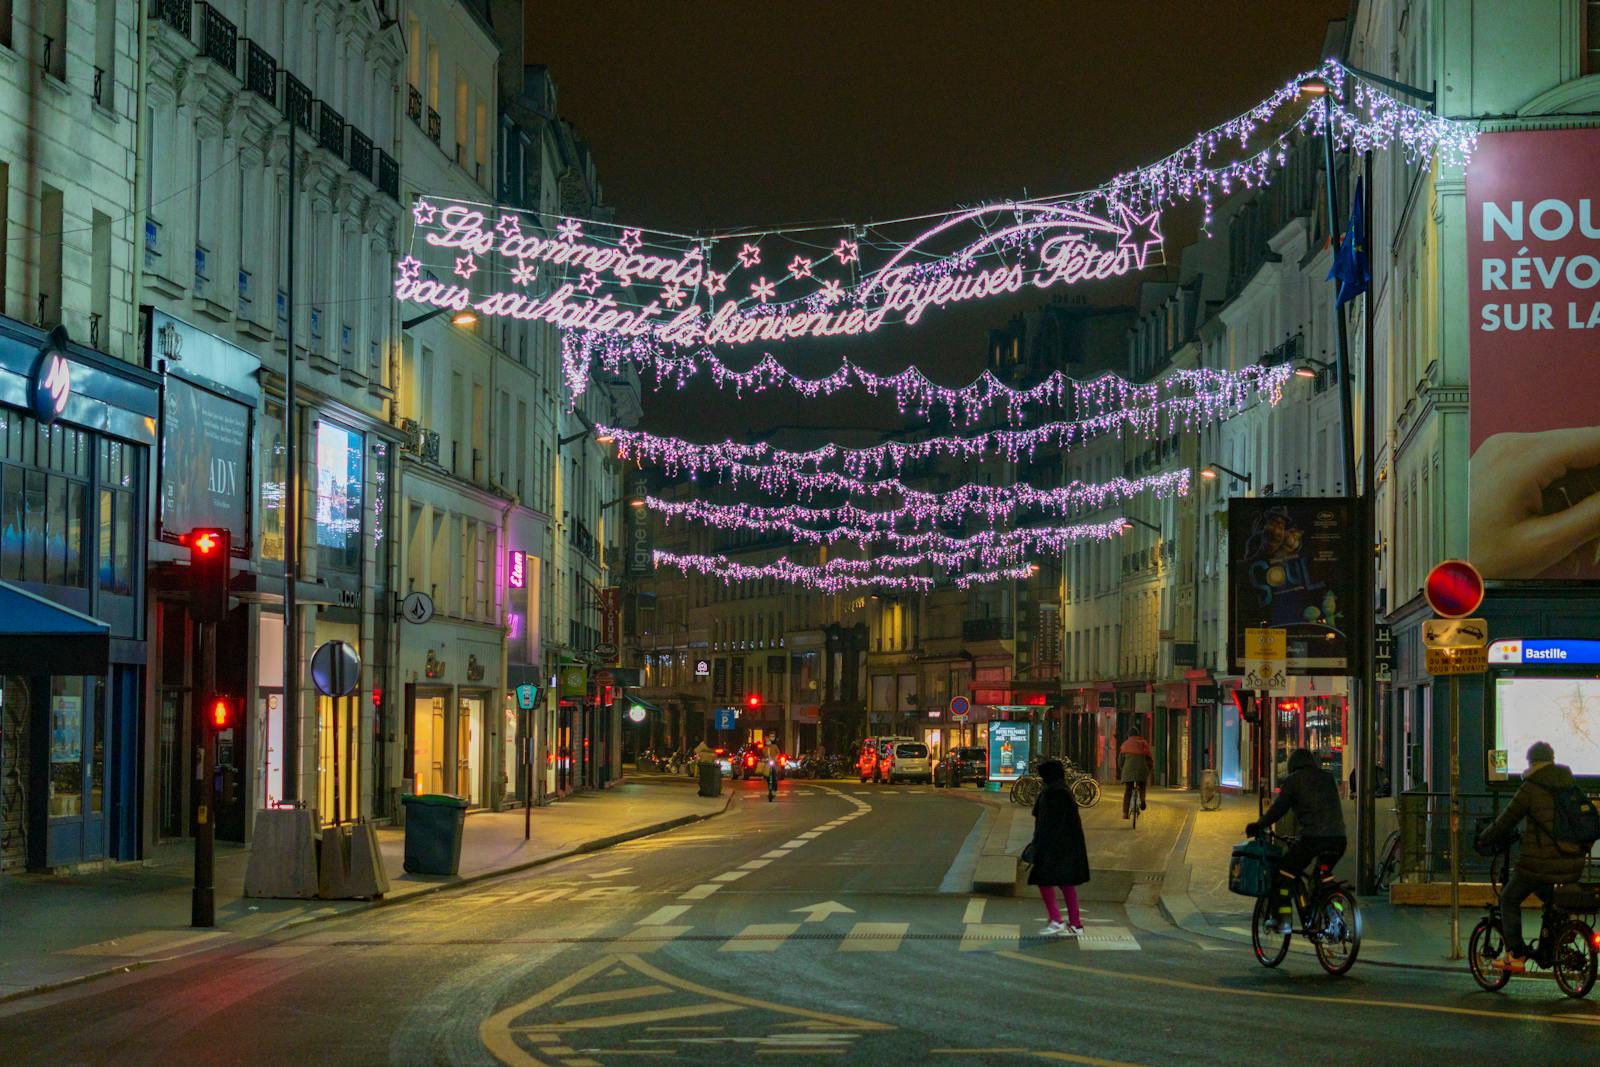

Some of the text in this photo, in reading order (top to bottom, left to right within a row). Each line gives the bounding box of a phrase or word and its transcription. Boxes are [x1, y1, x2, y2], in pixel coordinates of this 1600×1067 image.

[1482, 199, 1600, 241] NOU
[427, 206, 705, 287] Les commerçants
[865, 234, 1130, 331] Joyeuses Fêtes
[1481, 246, 1600, 291] RÉVO
[395, 276, 866, 346] vous souhaitent la bienvenue
[1481, 303, 1554, 332] SUR
[207, 456, 237, 496] ADN
[631, 478, 650, 571] ligne roet
[1525, 648, 1567, 659] Bastille
[721, 716, 728, 725] P
